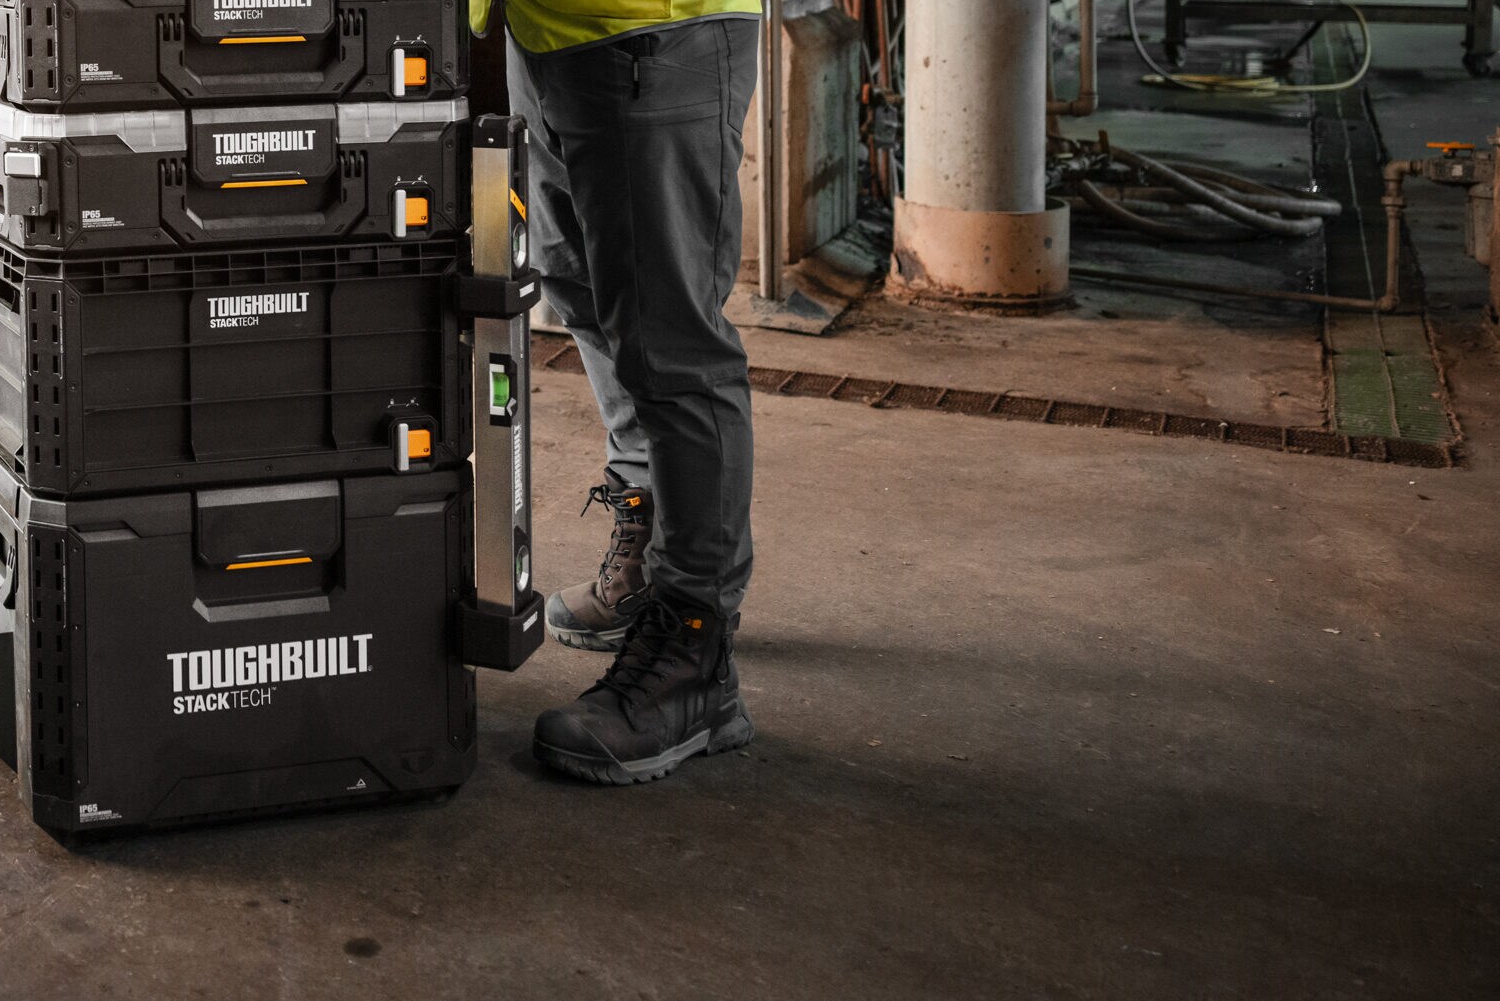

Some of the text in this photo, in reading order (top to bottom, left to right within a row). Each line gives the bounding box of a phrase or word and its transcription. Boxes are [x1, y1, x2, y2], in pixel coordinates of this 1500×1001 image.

[214, 8, 263, 21] STACKTECH
[80, 63, 99, 73] IP65
[213, 129, 316, 155] TOUGHBUILT
[216, 153, 265, 166] STACKTECH
[82, 210, 101, 219] IP65
[207, 292, 309, 317] TOUGHBUILT
[210, 314, 259, 329] STACKTECH
[167, 633, 373, 692] TOUGHBUILT
[173, 688, 272, 715] STACKTECH
[80, 804, 98, 814] IP65
